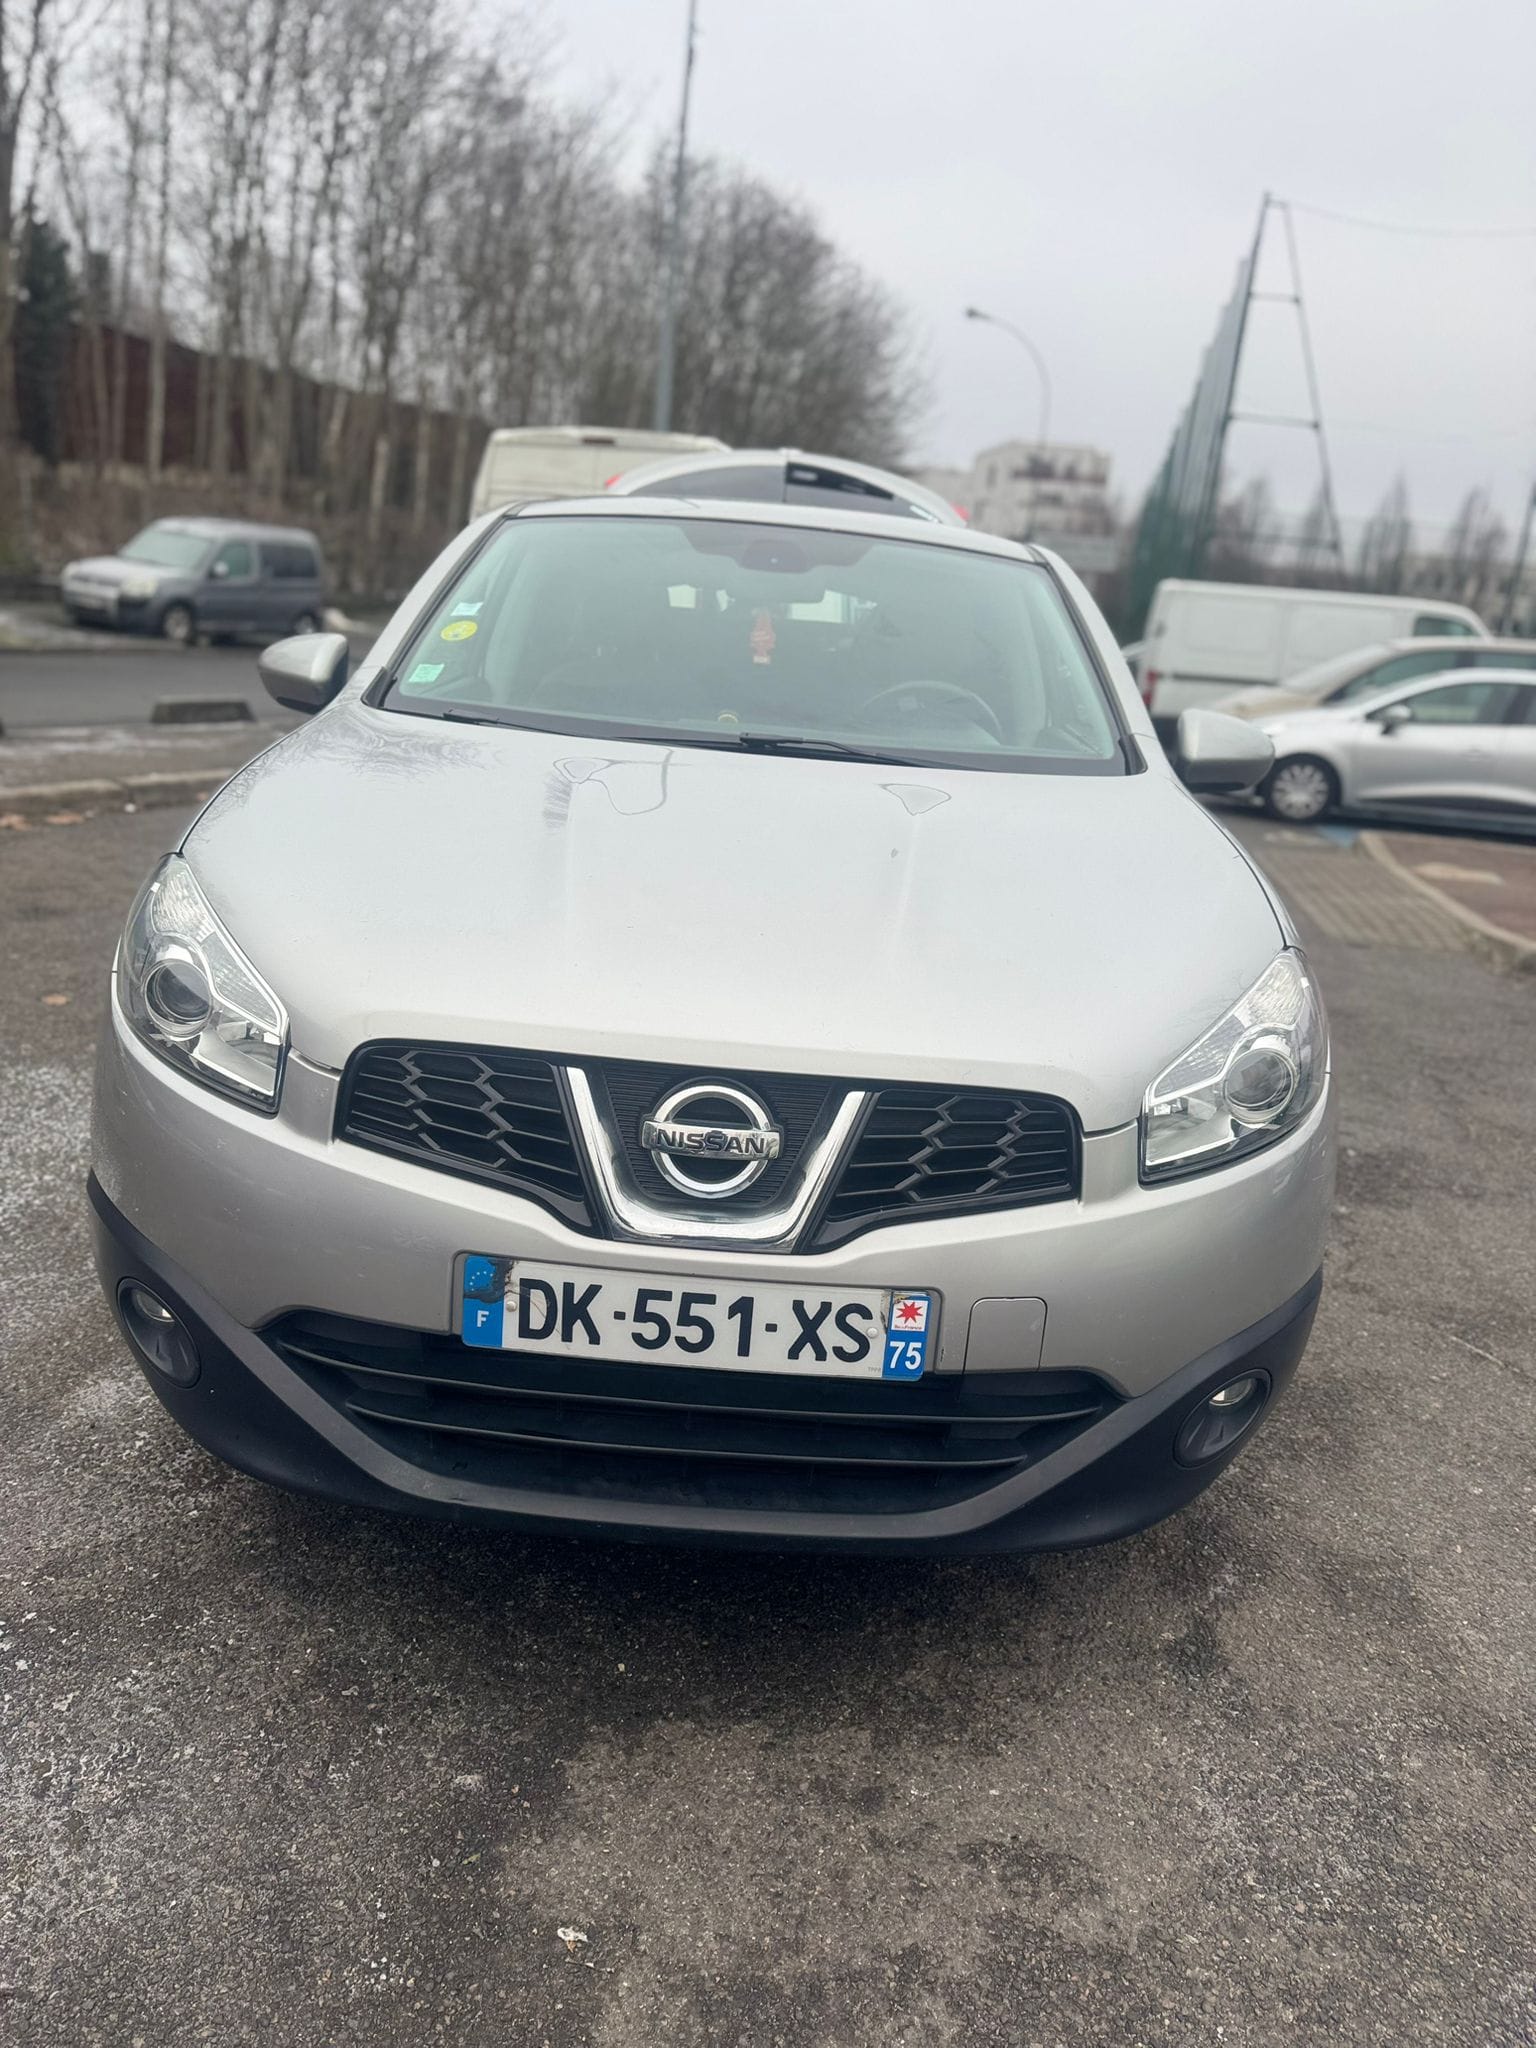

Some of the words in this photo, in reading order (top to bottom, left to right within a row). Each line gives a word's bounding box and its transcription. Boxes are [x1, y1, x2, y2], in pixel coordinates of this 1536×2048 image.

[656, 1128, 765, 1154] NISSAN
[477, 1309, 490, 1328] F
[518, 1277, 874, 1363] DK-551-XS
[889, 1340, 923, 1371] 75
